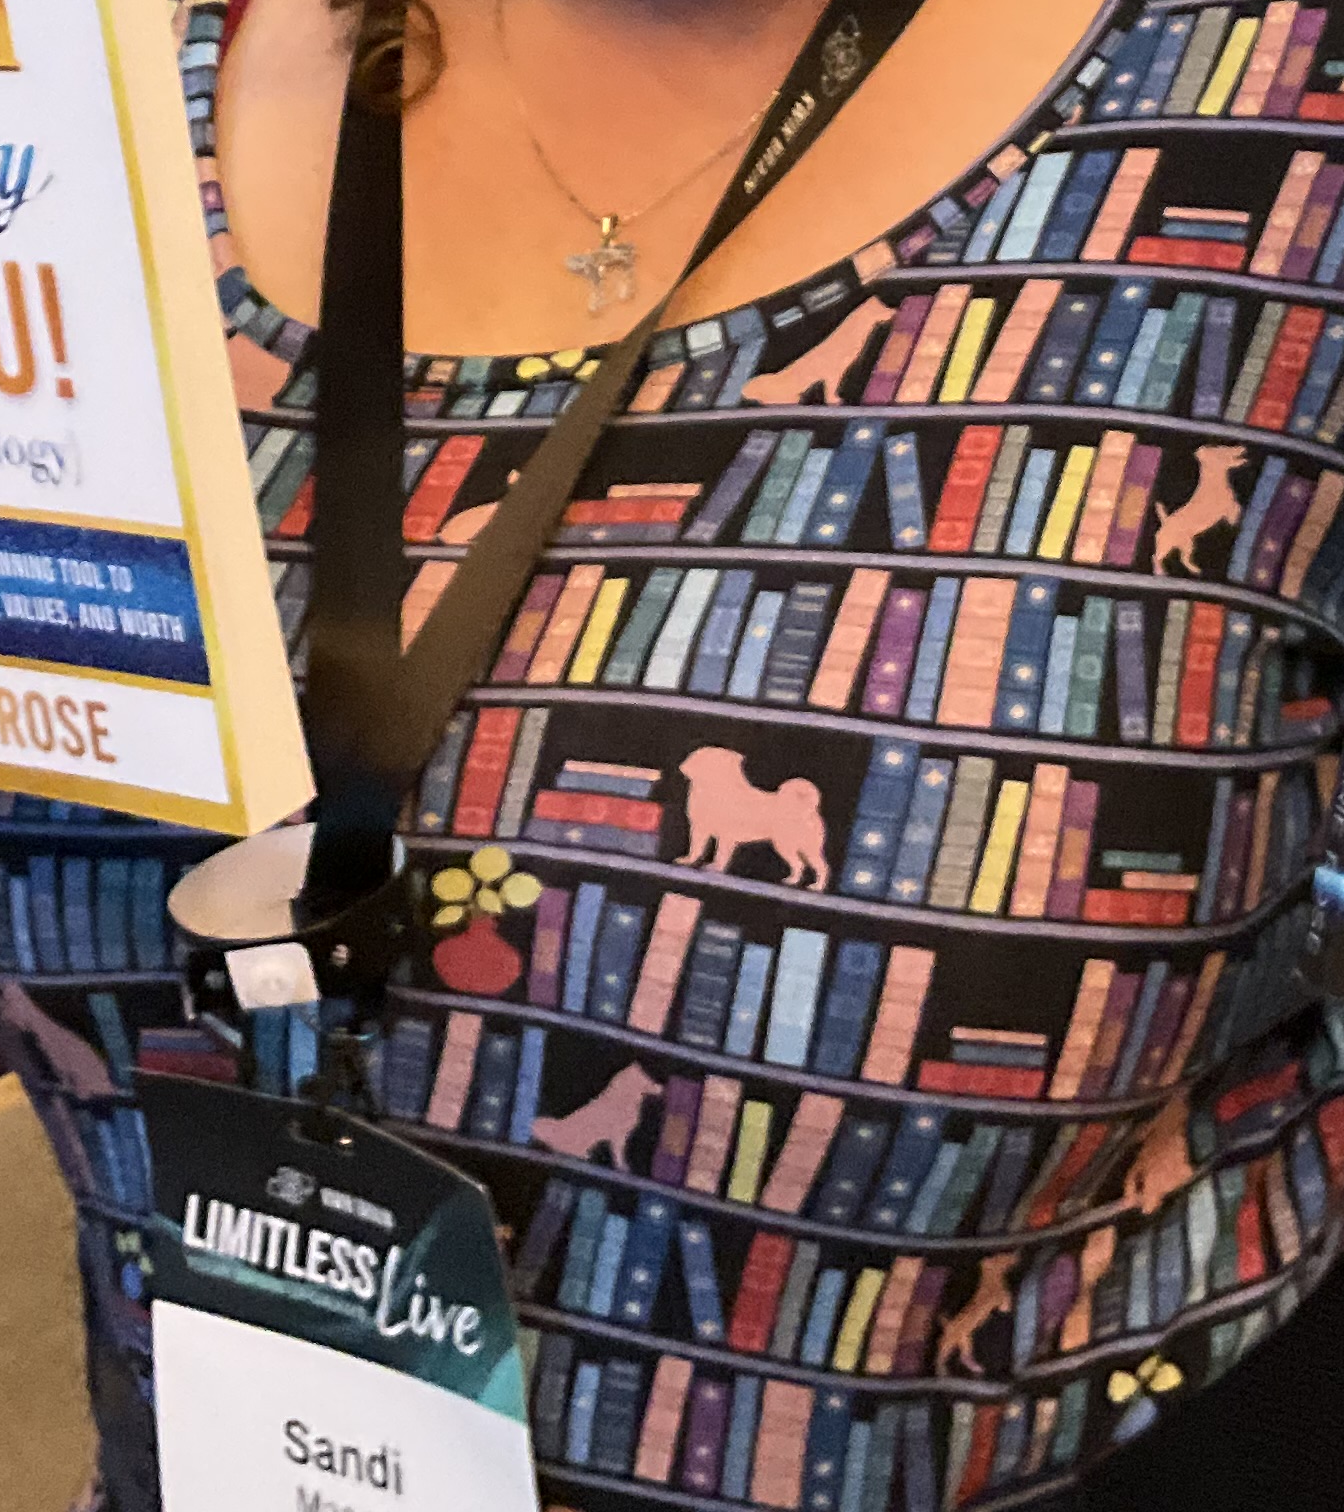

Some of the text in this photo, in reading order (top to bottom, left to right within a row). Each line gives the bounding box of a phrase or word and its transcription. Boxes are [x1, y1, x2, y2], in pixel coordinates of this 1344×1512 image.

[57, 557, 106, 590] TOOL
[107, 564, 134, 593] TO
[79, 602, 117, 632] AND
[117, 607, 186, 643] WORTH
[181, 1193, 484, 1356] LIMITLESS Live
[284, 1419, 403, 1496] Sandi
